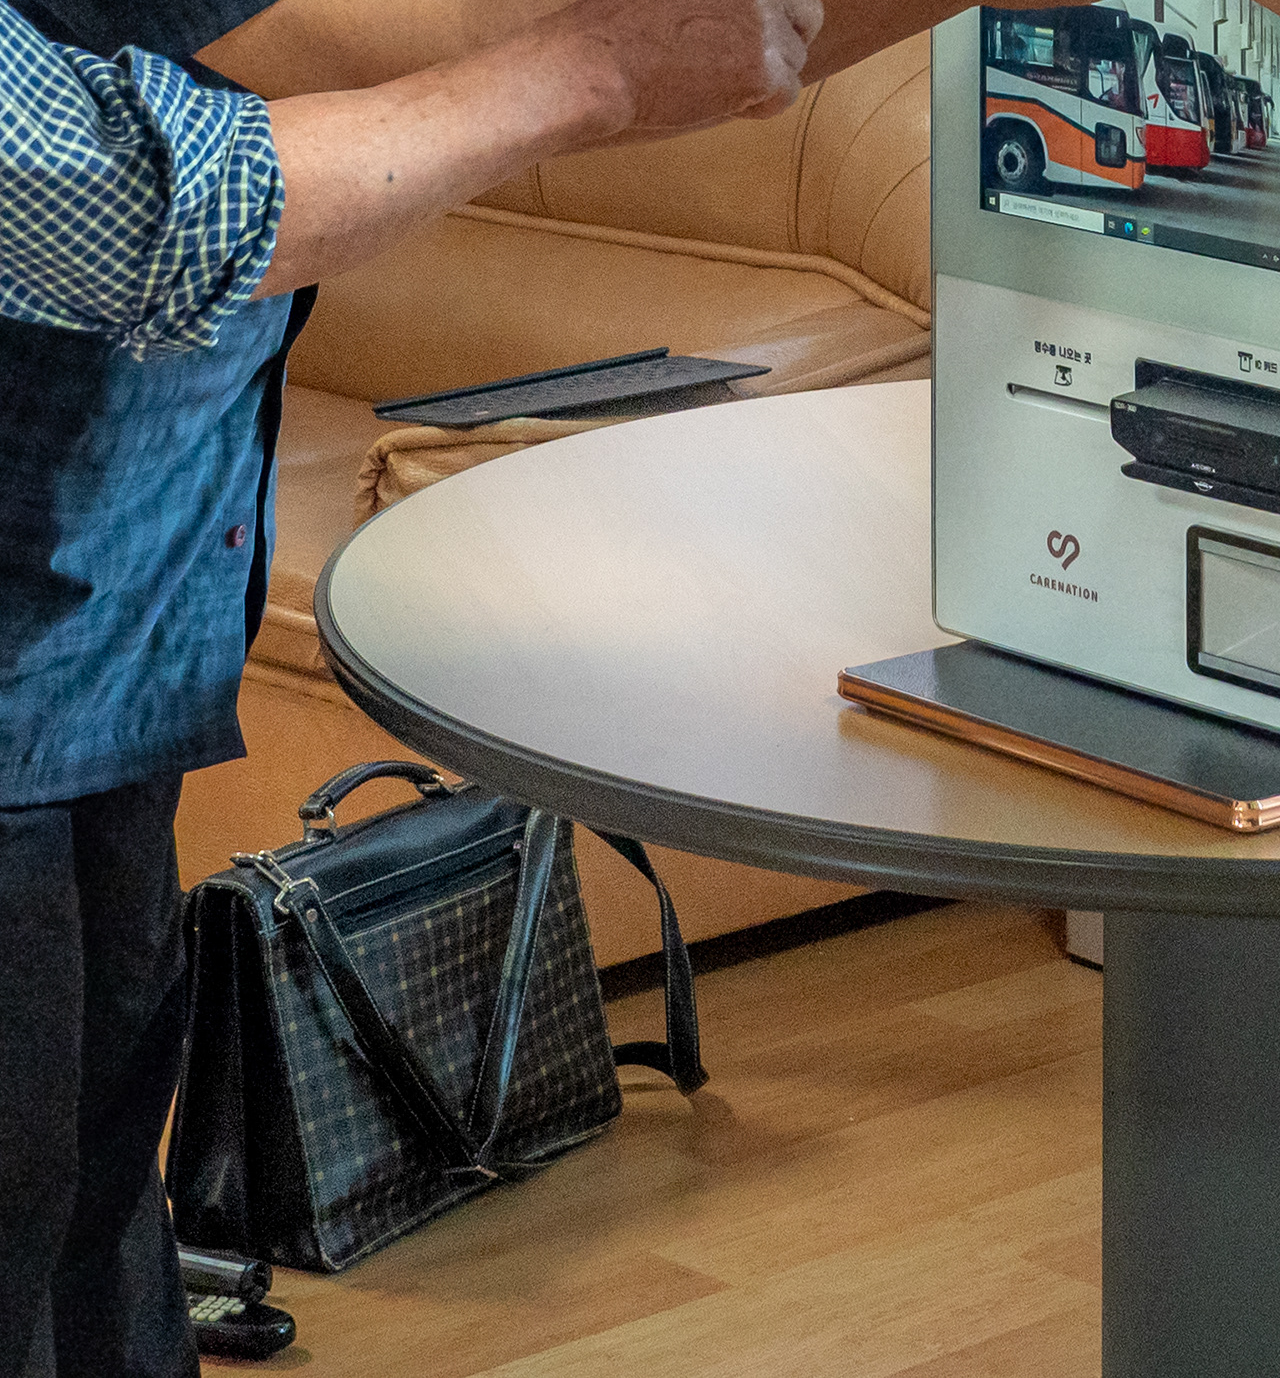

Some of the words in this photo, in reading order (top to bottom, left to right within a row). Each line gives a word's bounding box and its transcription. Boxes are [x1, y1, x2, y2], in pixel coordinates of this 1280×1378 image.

[1059, 345, 1082, 362] 나오는
[1084, 352, 1092, 365] 곳
[1029, 573, 1098, 603] CARENATION
